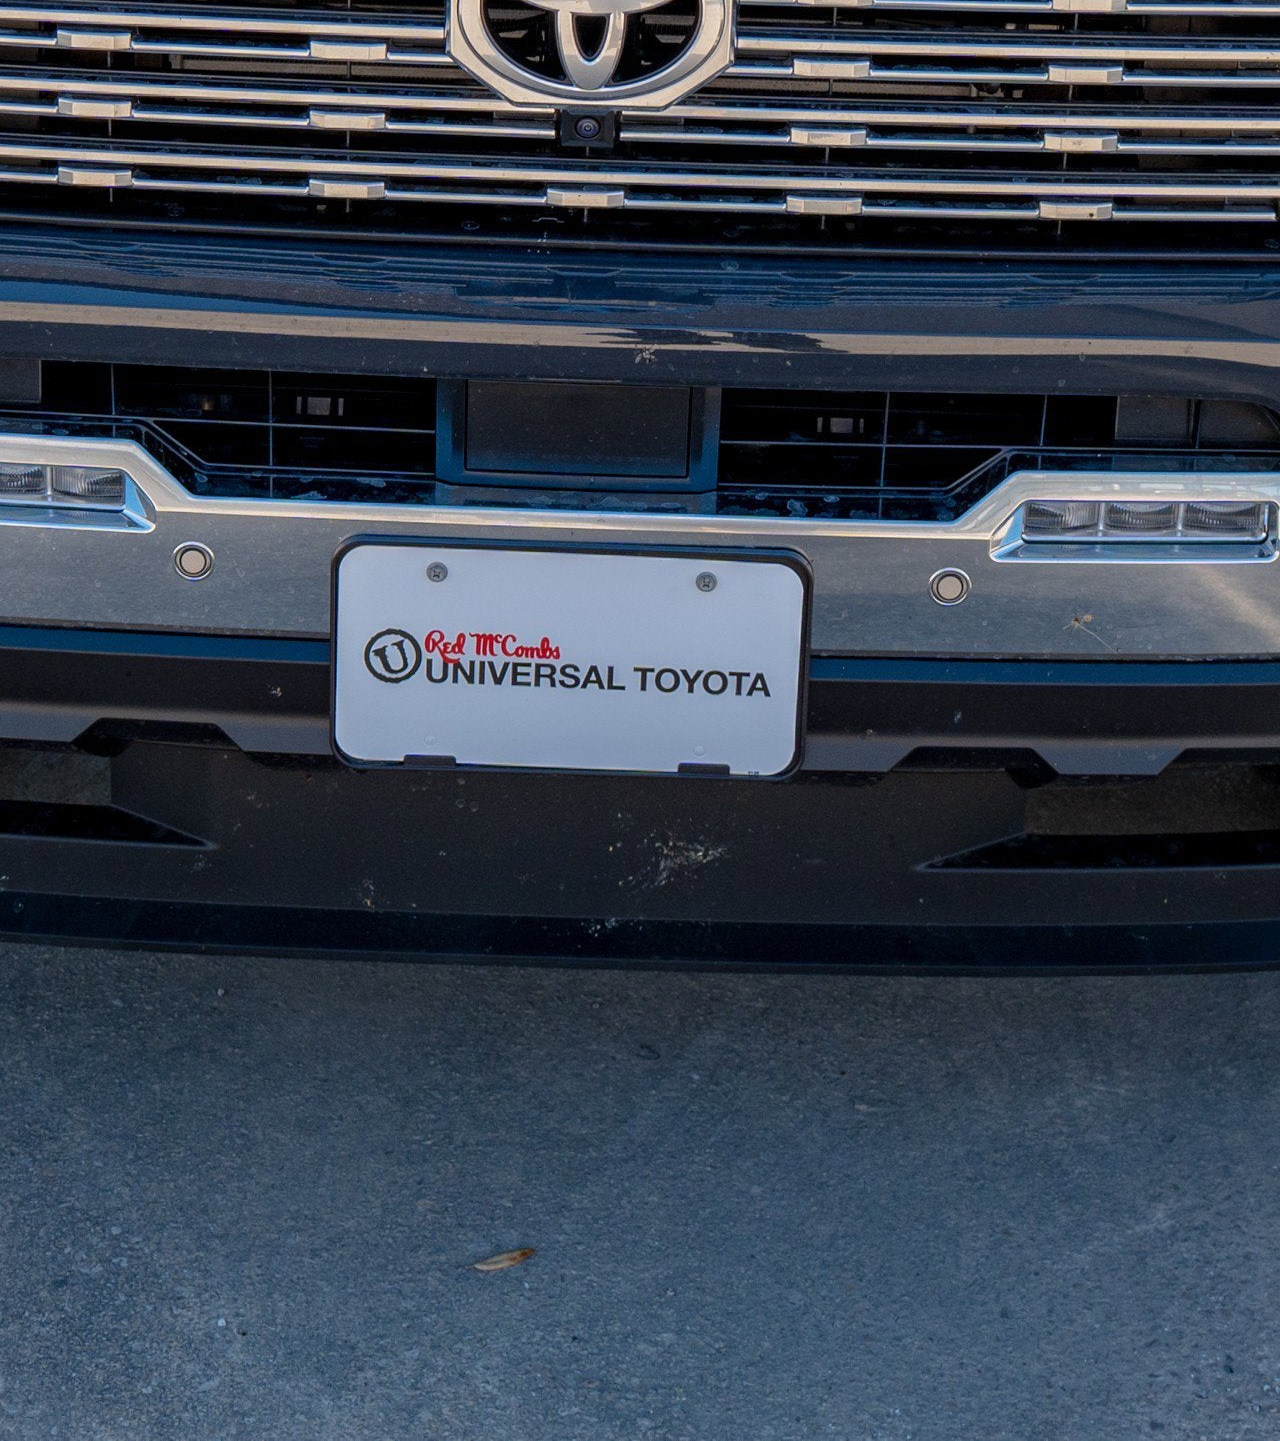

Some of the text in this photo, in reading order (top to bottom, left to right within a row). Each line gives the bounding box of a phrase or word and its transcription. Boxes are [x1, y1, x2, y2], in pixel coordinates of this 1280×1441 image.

[424, 630, 561, 664] Red McCombs
[425, 658, 771, 698] UNIVERSAL TOYOTA
